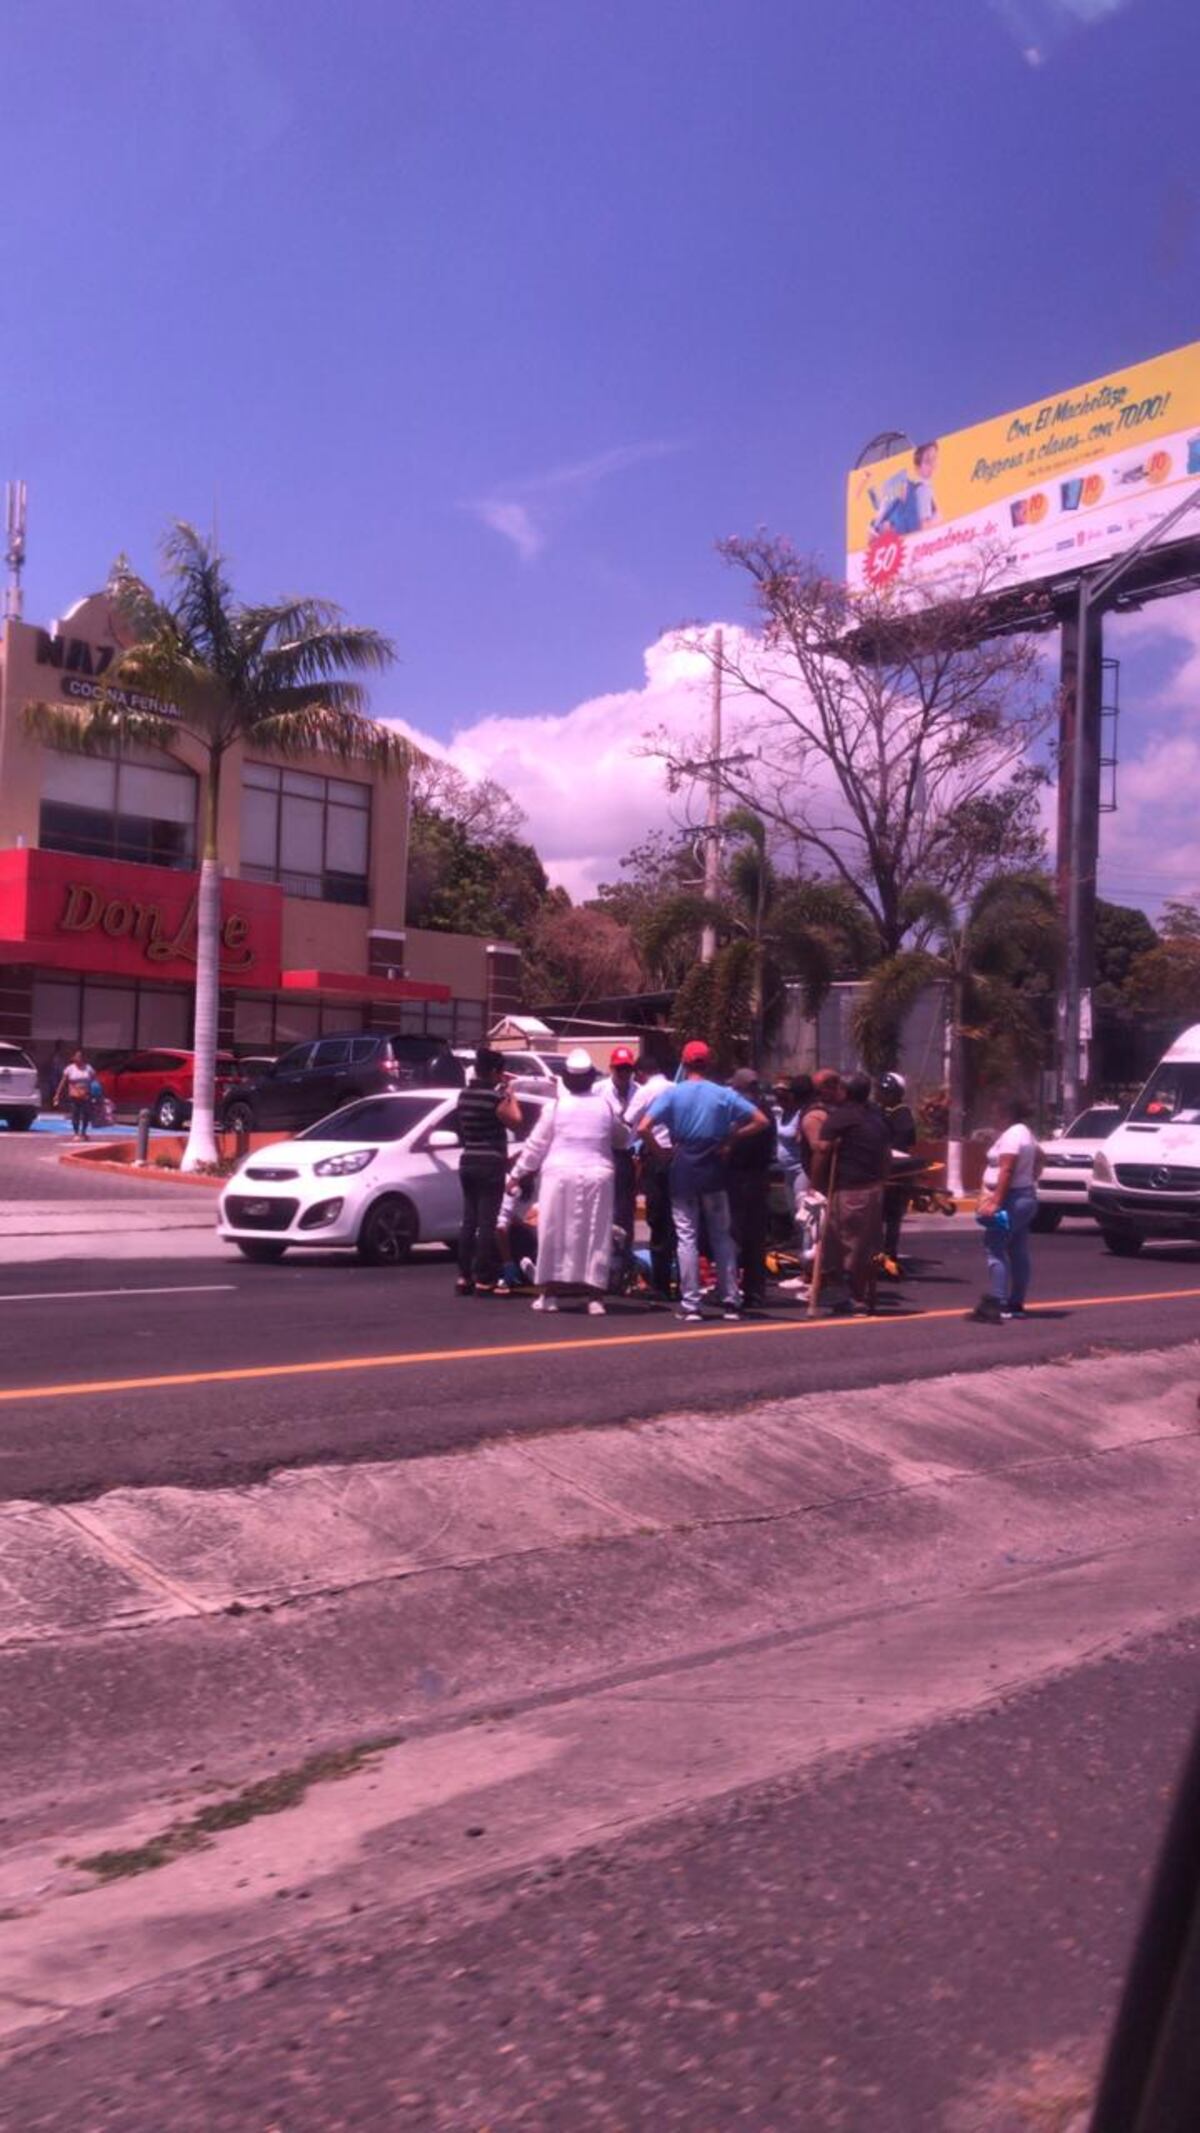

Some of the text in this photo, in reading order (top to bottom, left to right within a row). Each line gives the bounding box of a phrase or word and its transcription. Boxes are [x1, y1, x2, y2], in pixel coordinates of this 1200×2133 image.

[1006, 418, 1032, 443] Con
[1034, 405, 1053, 432] El
[1115, 391, 1172, 432] TODO!
[870, 543, 897, 577] 50
[36, 630, 115, 676] NAZ
[69, 680, 183, 718] COCNA PERUA
[58, 880, 256, 972] Don Le
